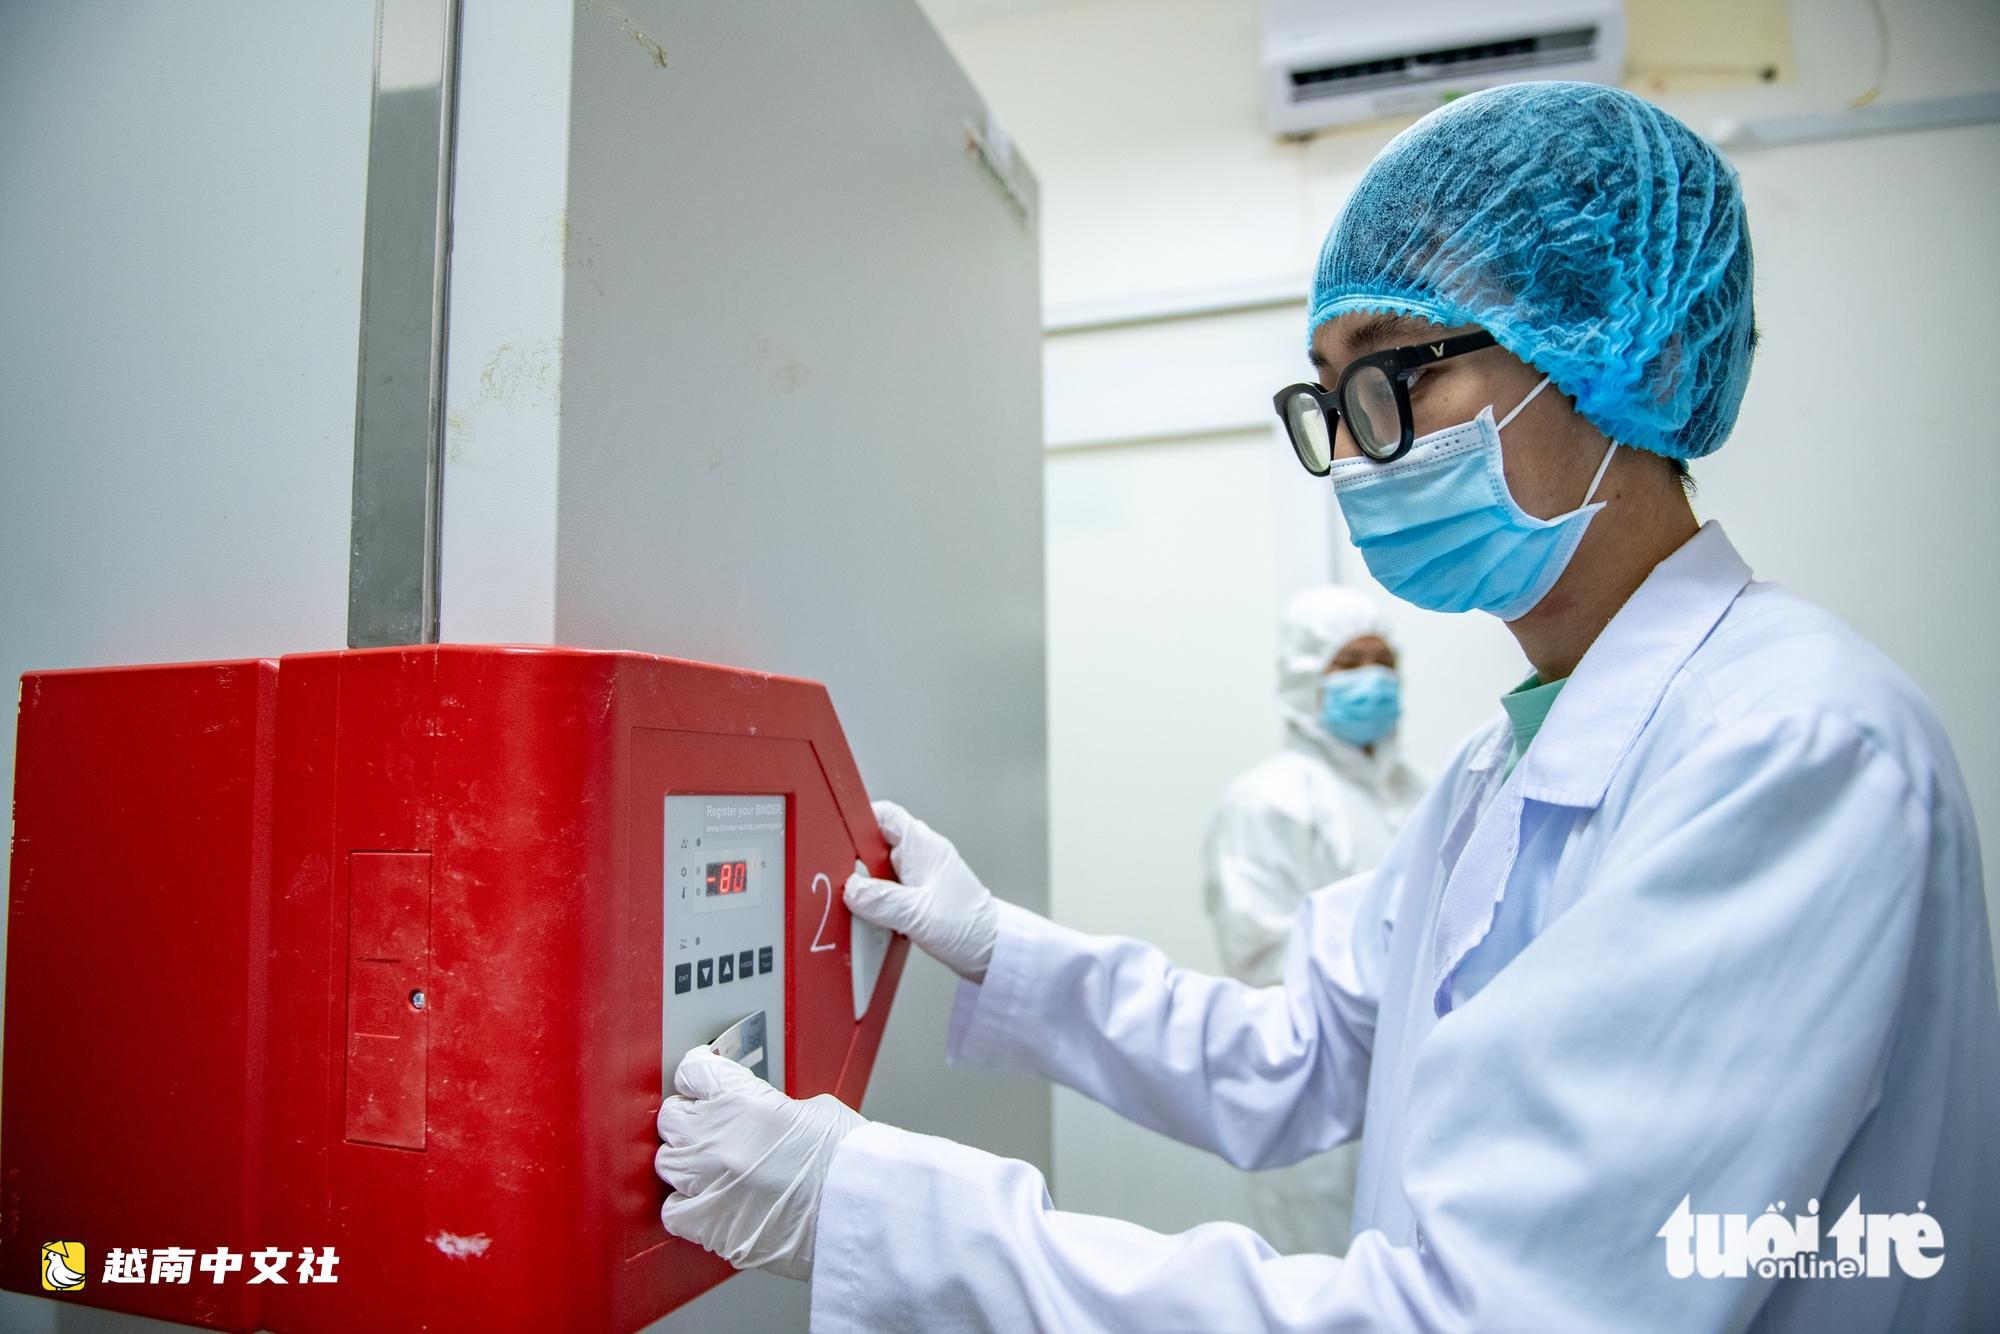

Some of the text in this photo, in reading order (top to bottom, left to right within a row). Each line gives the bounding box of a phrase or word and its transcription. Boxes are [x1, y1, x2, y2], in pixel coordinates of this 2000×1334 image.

[706, 805, 736, 819] Register
[737, 807, 754, 818] your
[707, 863, 746, 893] -80
[810, 872, 836, 952] 2
[678, 974, 689, 983] EXIT
